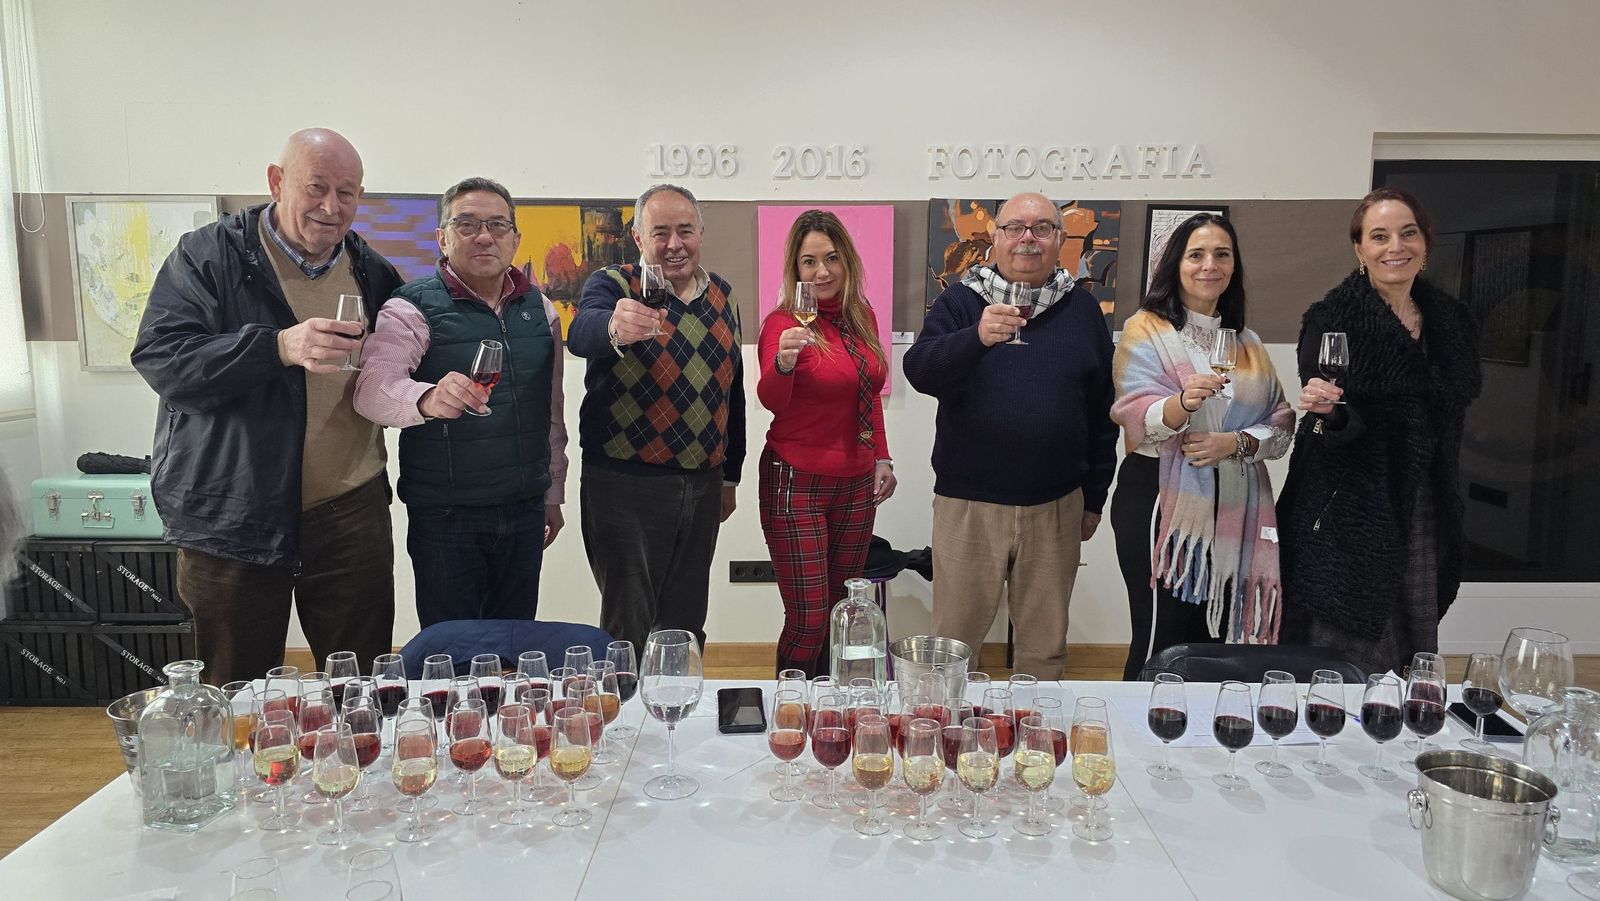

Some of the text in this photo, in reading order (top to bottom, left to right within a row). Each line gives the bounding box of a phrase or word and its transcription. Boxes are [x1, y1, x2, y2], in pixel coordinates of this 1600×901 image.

[648, 143, 1212, 180] 1996 2016 FOTOGRAFIA
[30, 564, 62, 591] STORAGE
[117, 565, 149, 592] STORAGE
[20, 648, 53, 674] STORAGE
[120, 649, 153, 675] STORAGE
